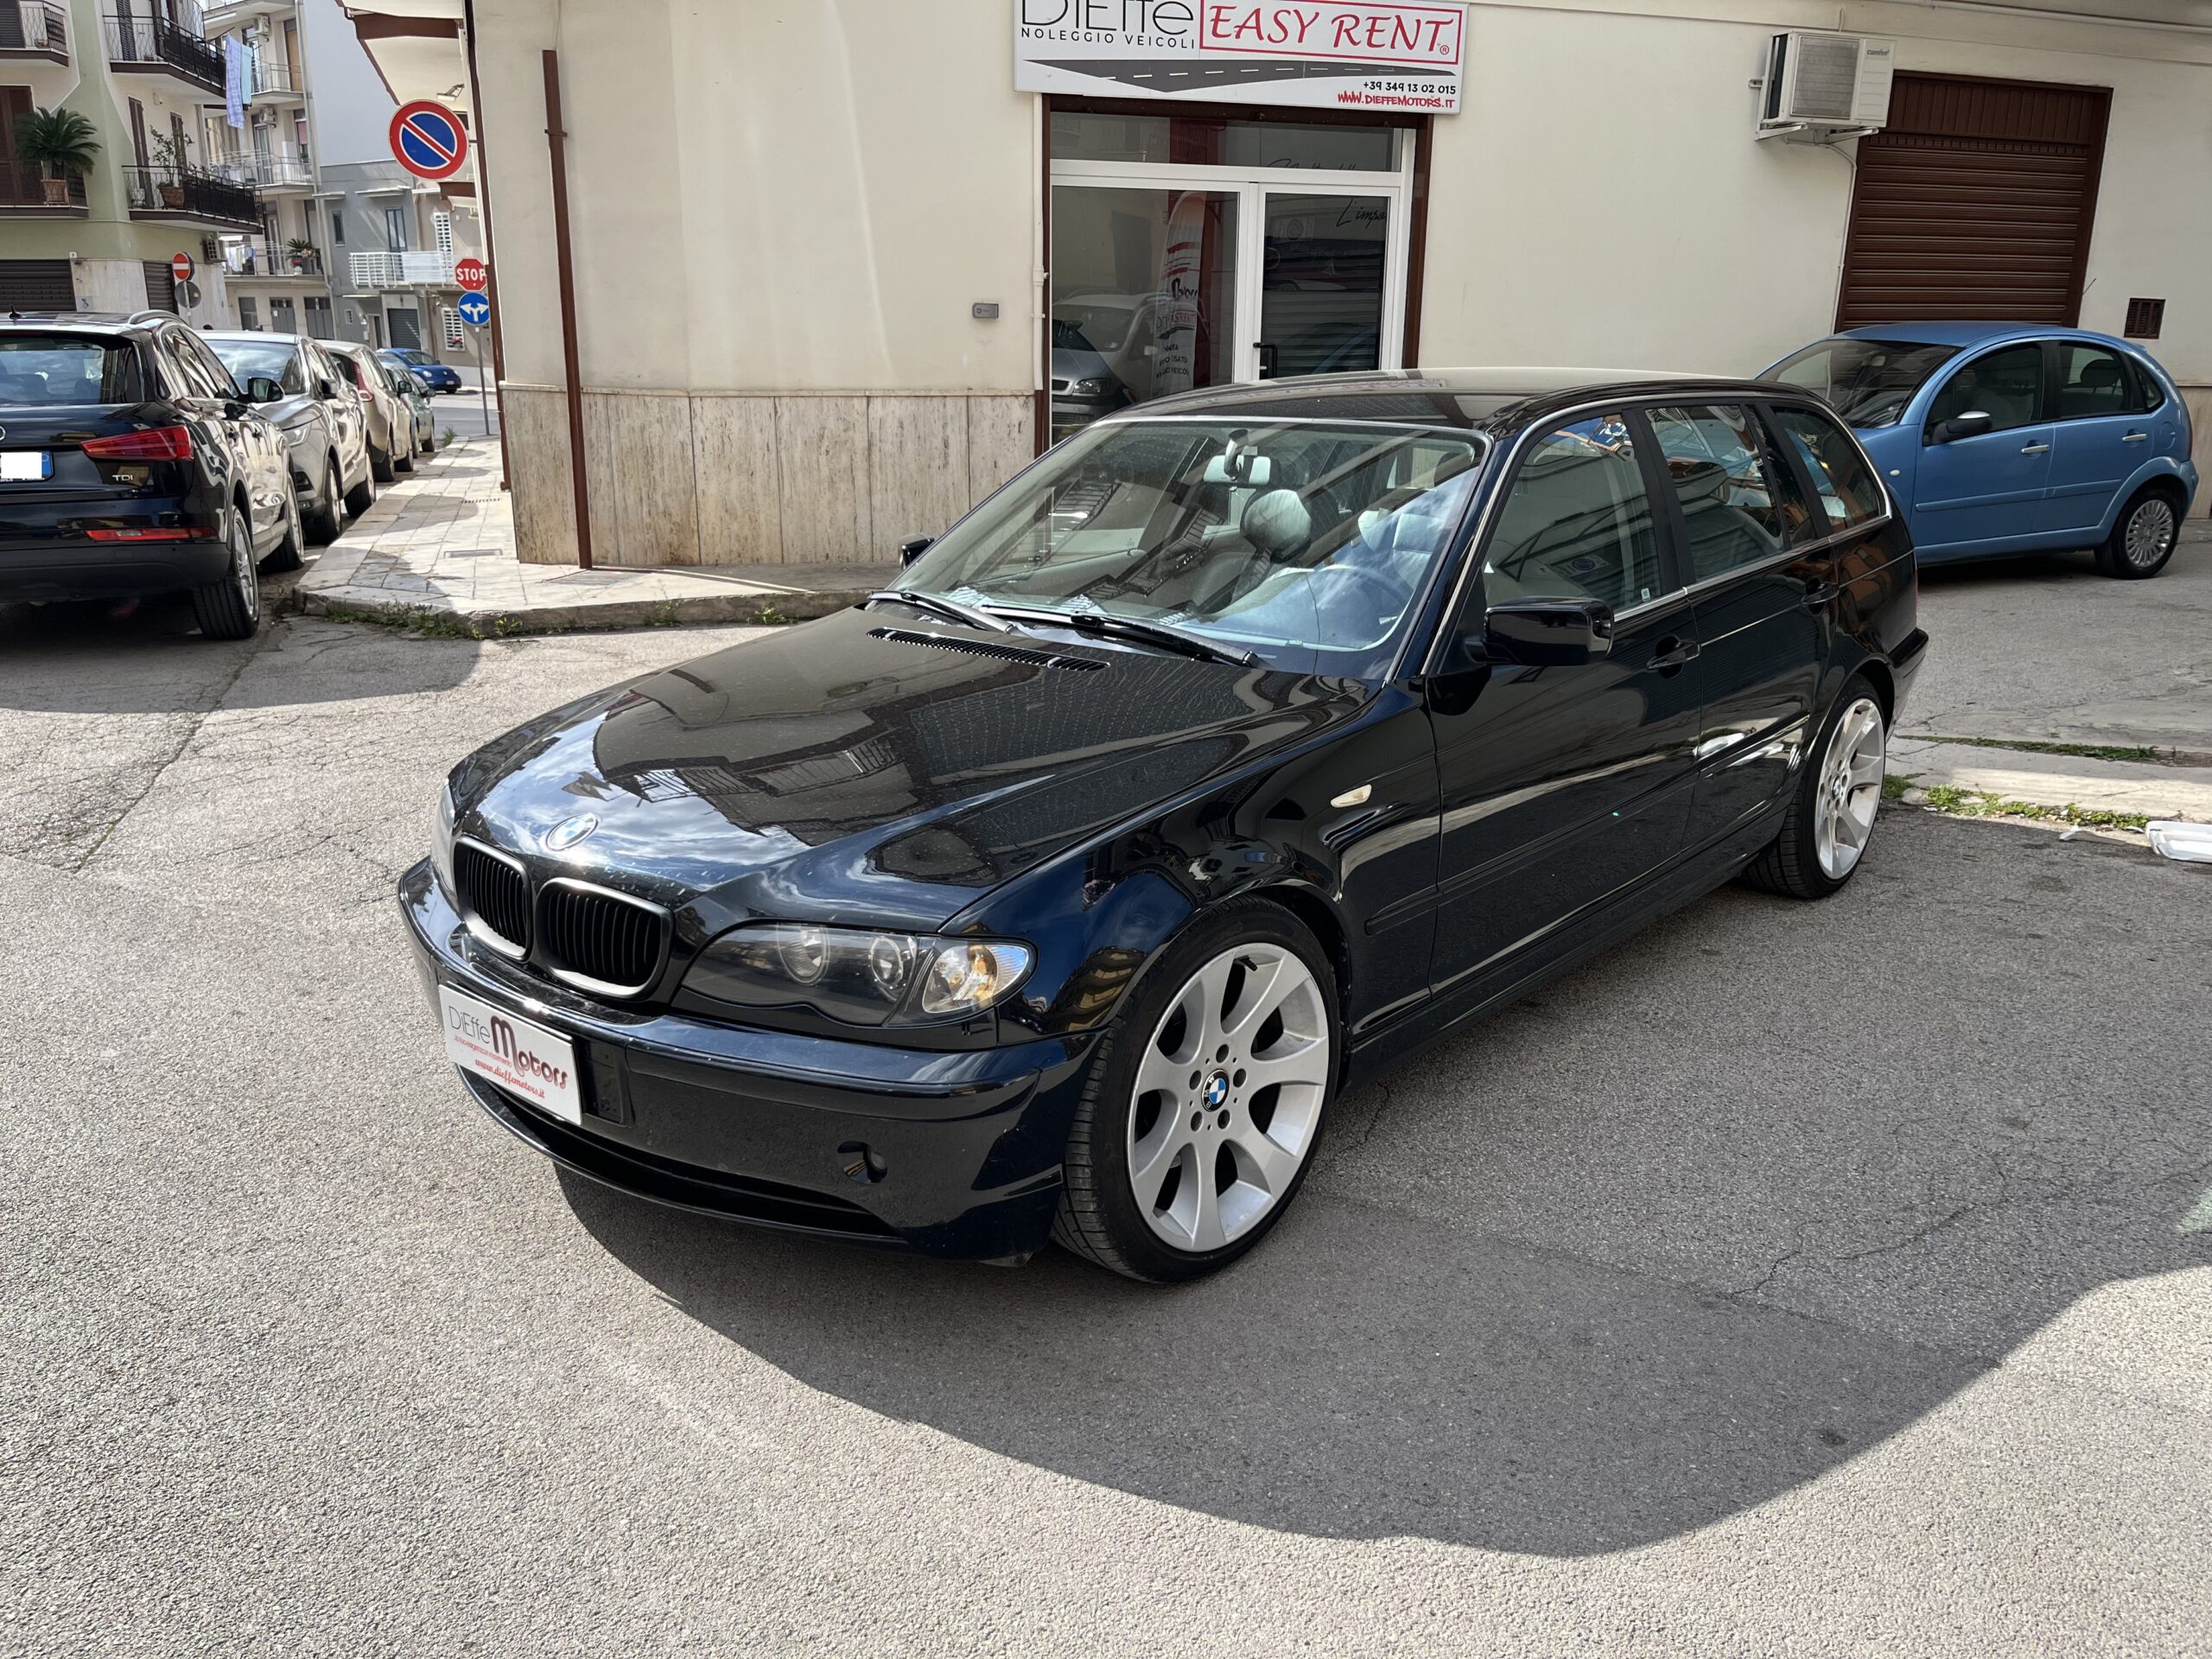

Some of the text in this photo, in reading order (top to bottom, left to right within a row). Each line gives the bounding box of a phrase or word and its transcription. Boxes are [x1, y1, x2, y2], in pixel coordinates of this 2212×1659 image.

[1210, 5, 1319, 43] EASY
[1021, 28, 1195, 49] NOLEGGIO VEICOLI
[1363, 81, 1457, 94] +39 349 13 02 015
[1338, 90, 1456, 108] WWW.DIEFFEMOTORS.IT
[456, 268, 486, 281] STOP
[448, 1005, 491, 1045] DiEffe
[490, 1014, 568, 1090] Motors
